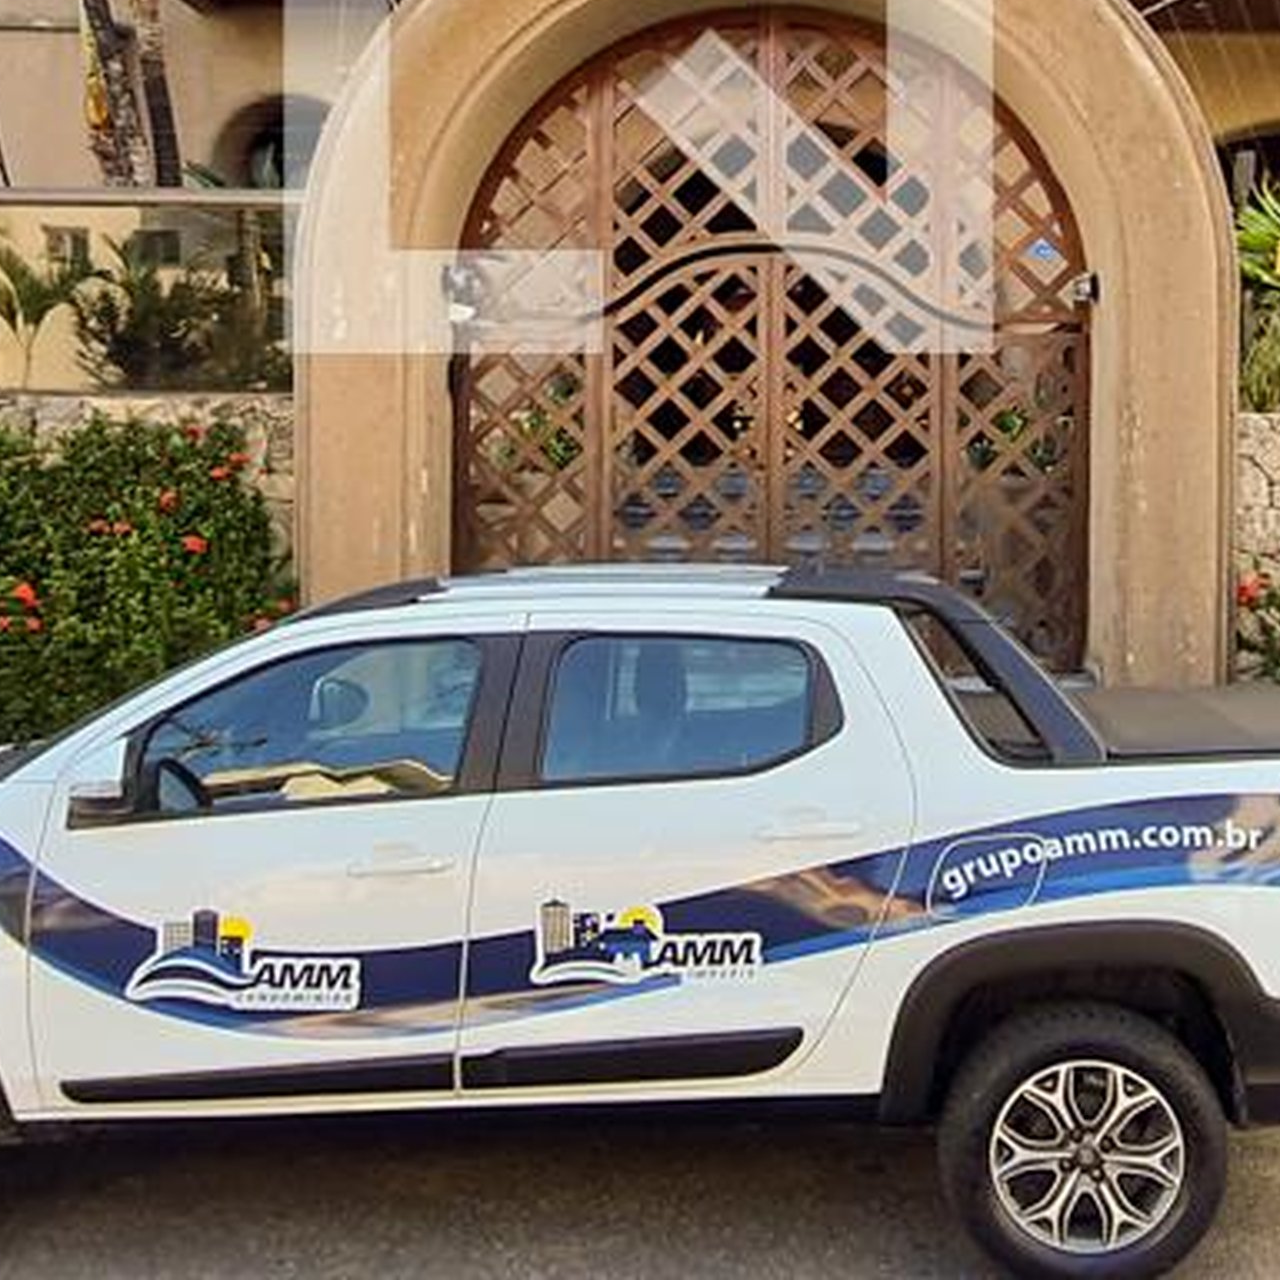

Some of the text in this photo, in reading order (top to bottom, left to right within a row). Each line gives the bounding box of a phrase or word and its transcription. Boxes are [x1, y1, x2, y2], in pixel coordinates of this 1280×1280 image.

[941, 819, 1263, 899] grupoamm.com.br
[656, 938, 755, 967] AMM
[254, 962, 354, 989] AMM
